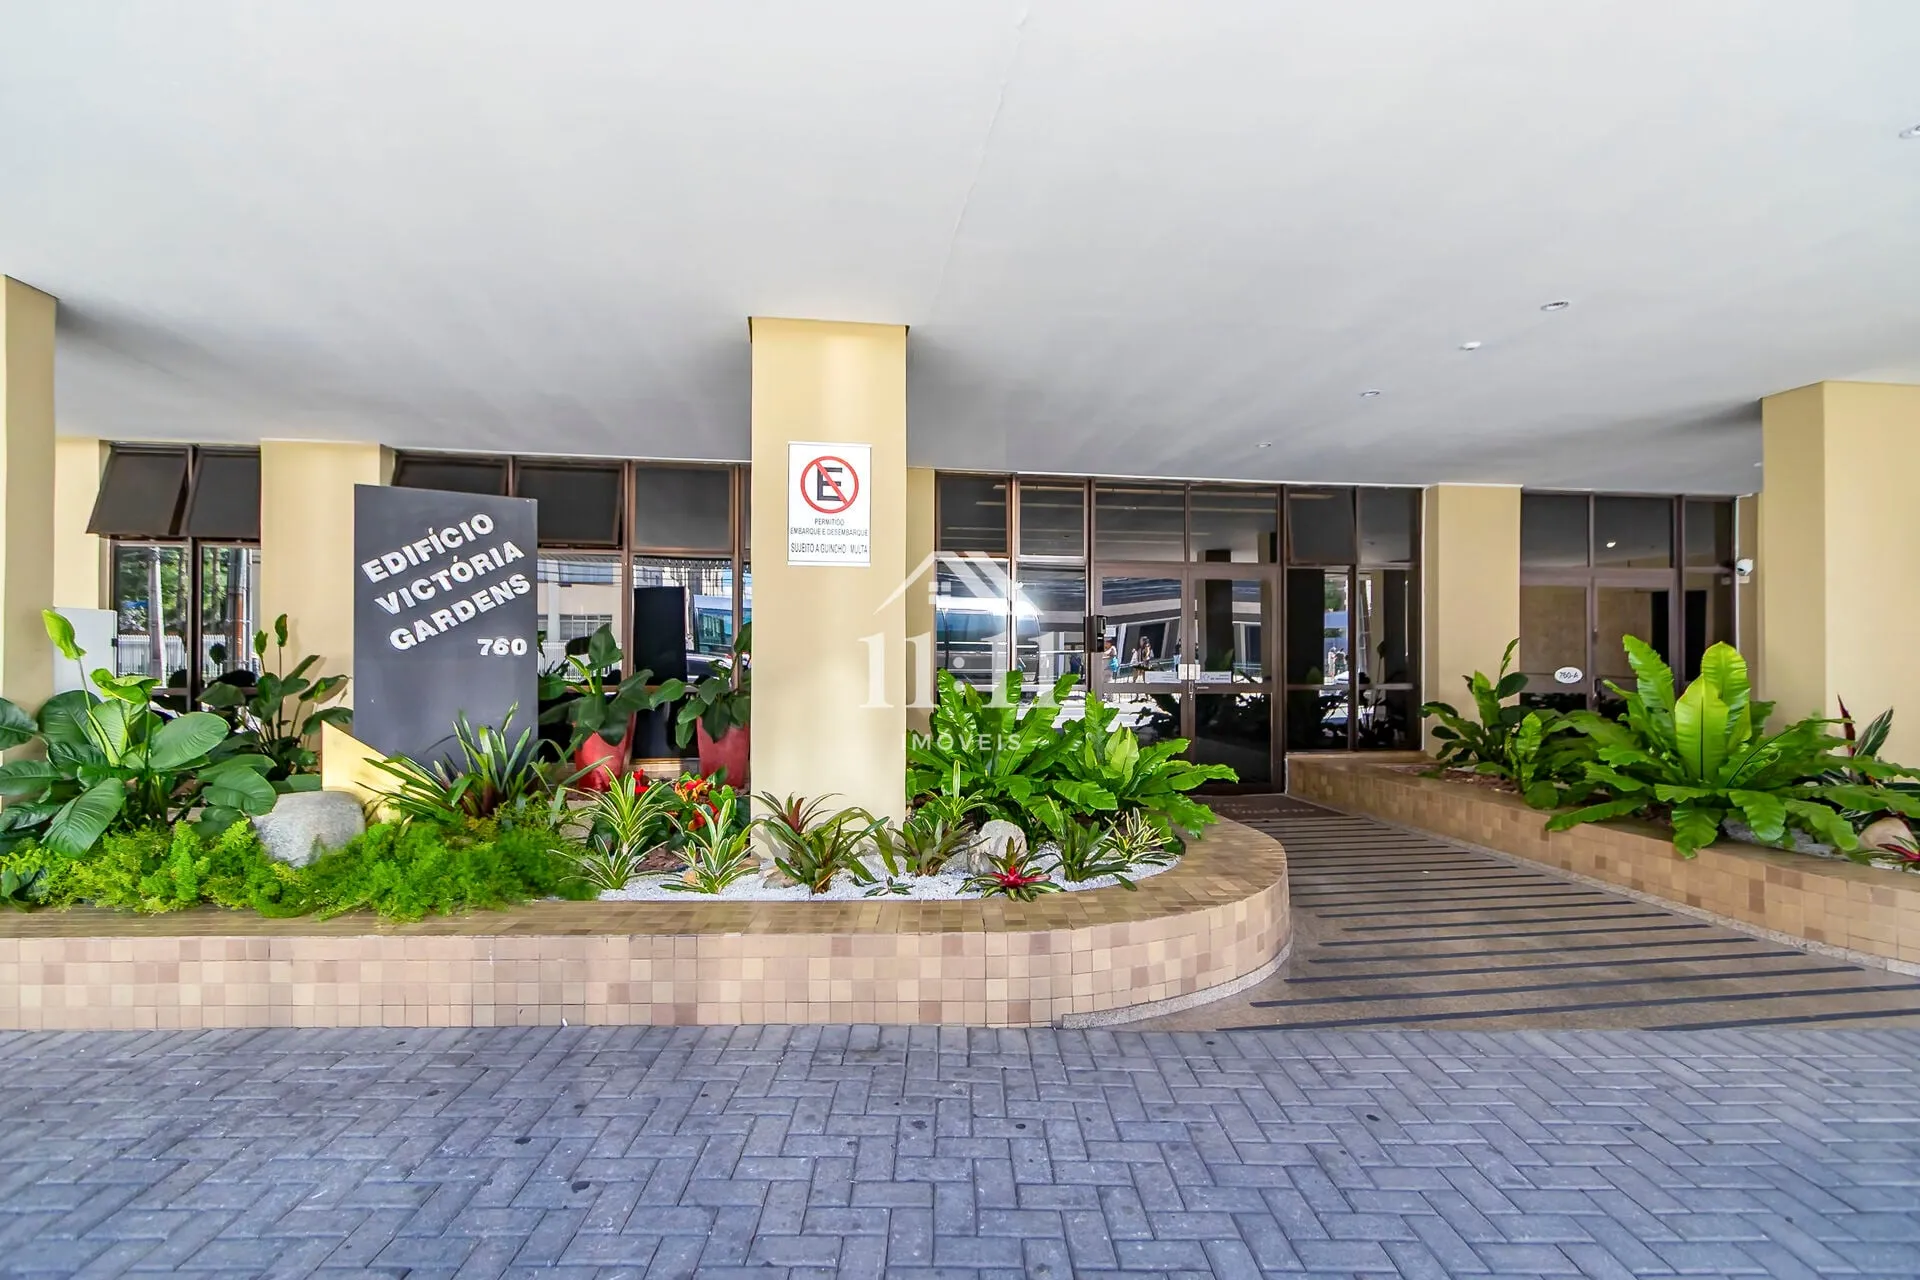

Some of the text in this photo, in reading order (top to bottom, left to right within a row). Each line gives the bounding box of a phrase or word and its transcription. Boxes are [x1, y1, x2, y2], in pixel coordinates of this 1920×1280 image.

[814, 518, 845, 526] PERMITIDO
[790, 527, 821, 536] EMBARQUE
[827, 528, 868, 537] DESEMBARQUE
[361, 513, 494, 584] EDIFÍCIO
[790, 542, 815, 553] SUJEITO
[820, 543, 846, 554] GUINCHO
[850, 544, 868, 555] MULTA
[374, 541, 525, 615] VICTÓRIA
[389, 574, 531, 651] GARDENS
[477, 637, 528, 656] 760
